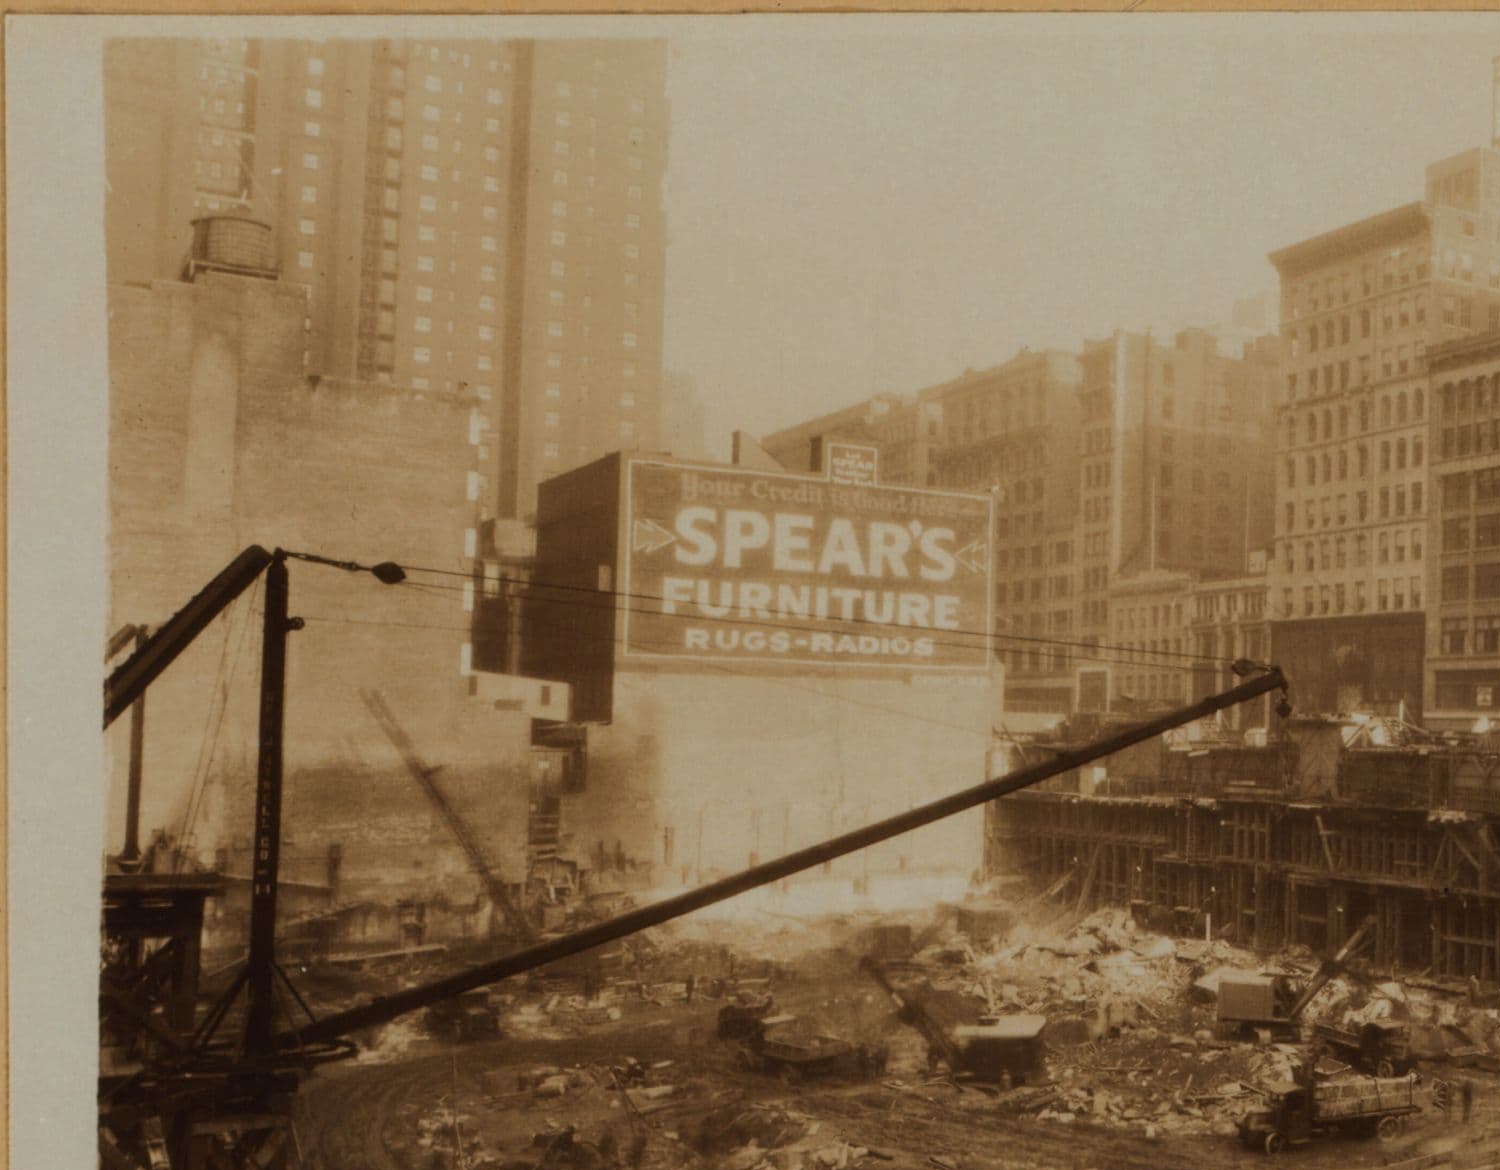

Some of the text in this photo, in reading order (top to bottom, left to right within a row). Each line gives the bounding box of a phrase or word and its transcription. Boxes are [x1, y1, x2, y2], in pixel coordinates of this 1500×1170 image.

[681, 473, 745, 501] Your
[751, 480, 823, 507] Credit
[674, 506, 956, 582] SPEAR'S
[661, 576, 961, 629] FURNITURE
[685, 628, 934, 657] RUGS-RADIOS
